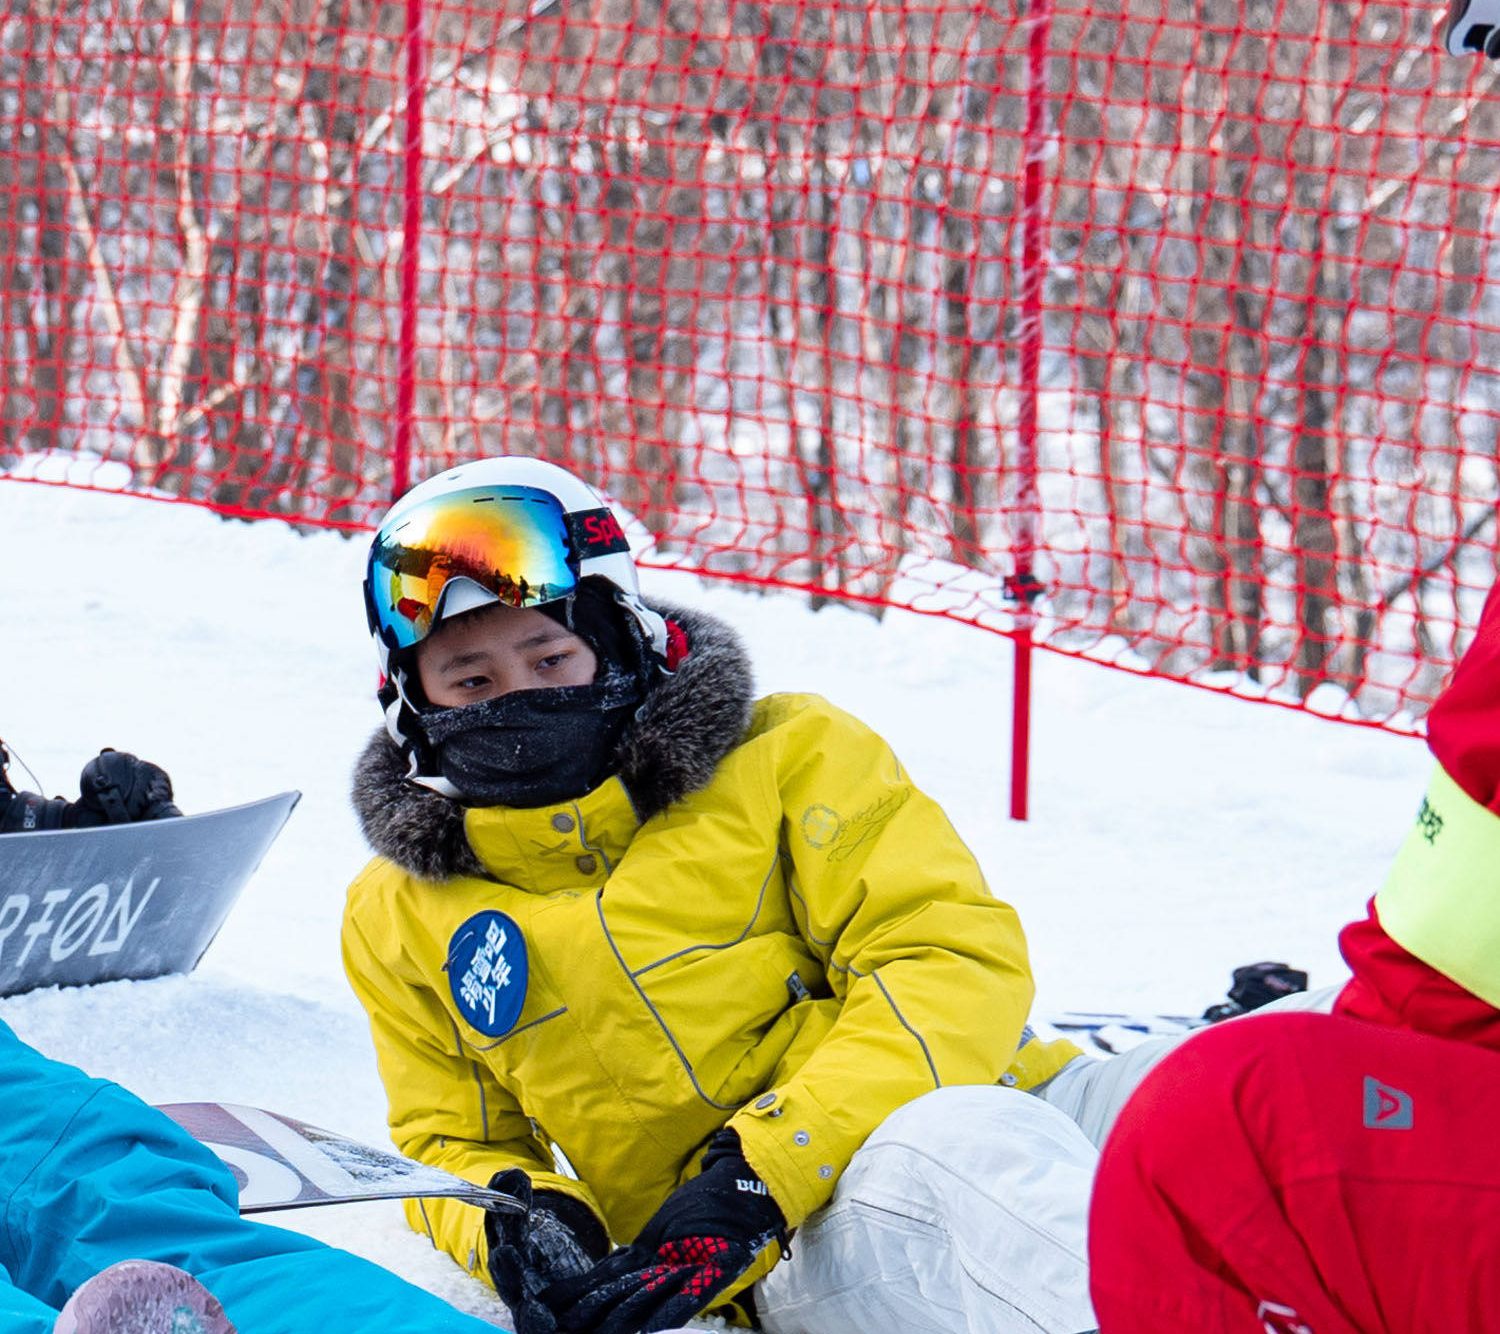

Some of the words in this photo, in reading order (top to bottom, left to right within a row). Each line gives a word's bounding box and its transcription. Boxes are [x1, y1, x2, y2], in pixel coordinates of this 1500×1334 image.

[460, 918, 507, 1011] 滑雪吧
[482, 953, 512, 1027] 少年
